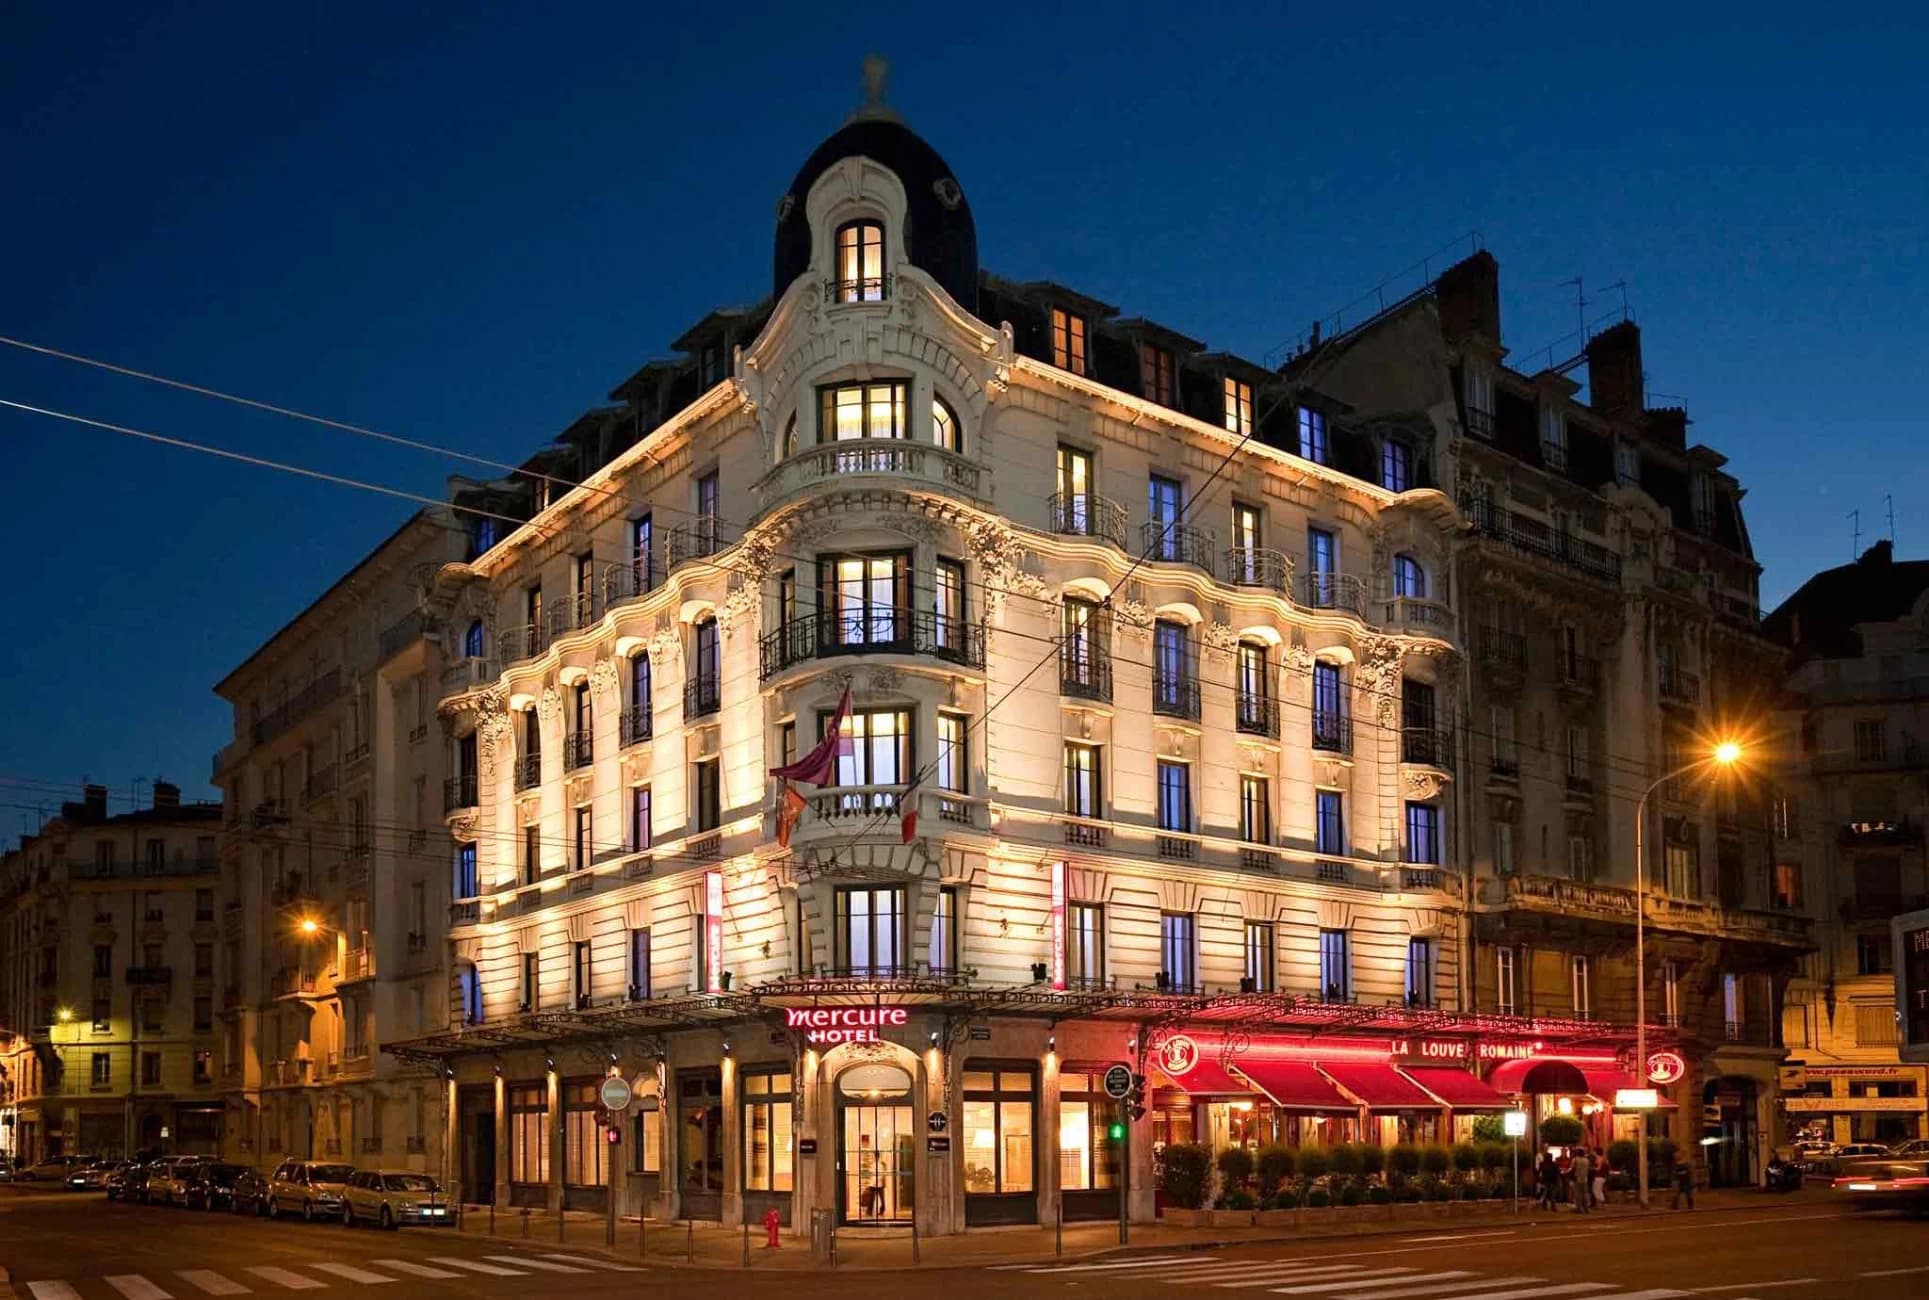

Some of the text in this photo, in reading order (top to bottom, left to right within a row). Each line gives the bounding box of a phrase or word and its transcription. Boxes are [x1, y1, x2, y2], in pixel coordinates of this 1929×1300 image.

[811, 1029, 880, 1042] HOTEL
[1392, 1041, 1534, 1059] LA LOUVE ROMAINE
